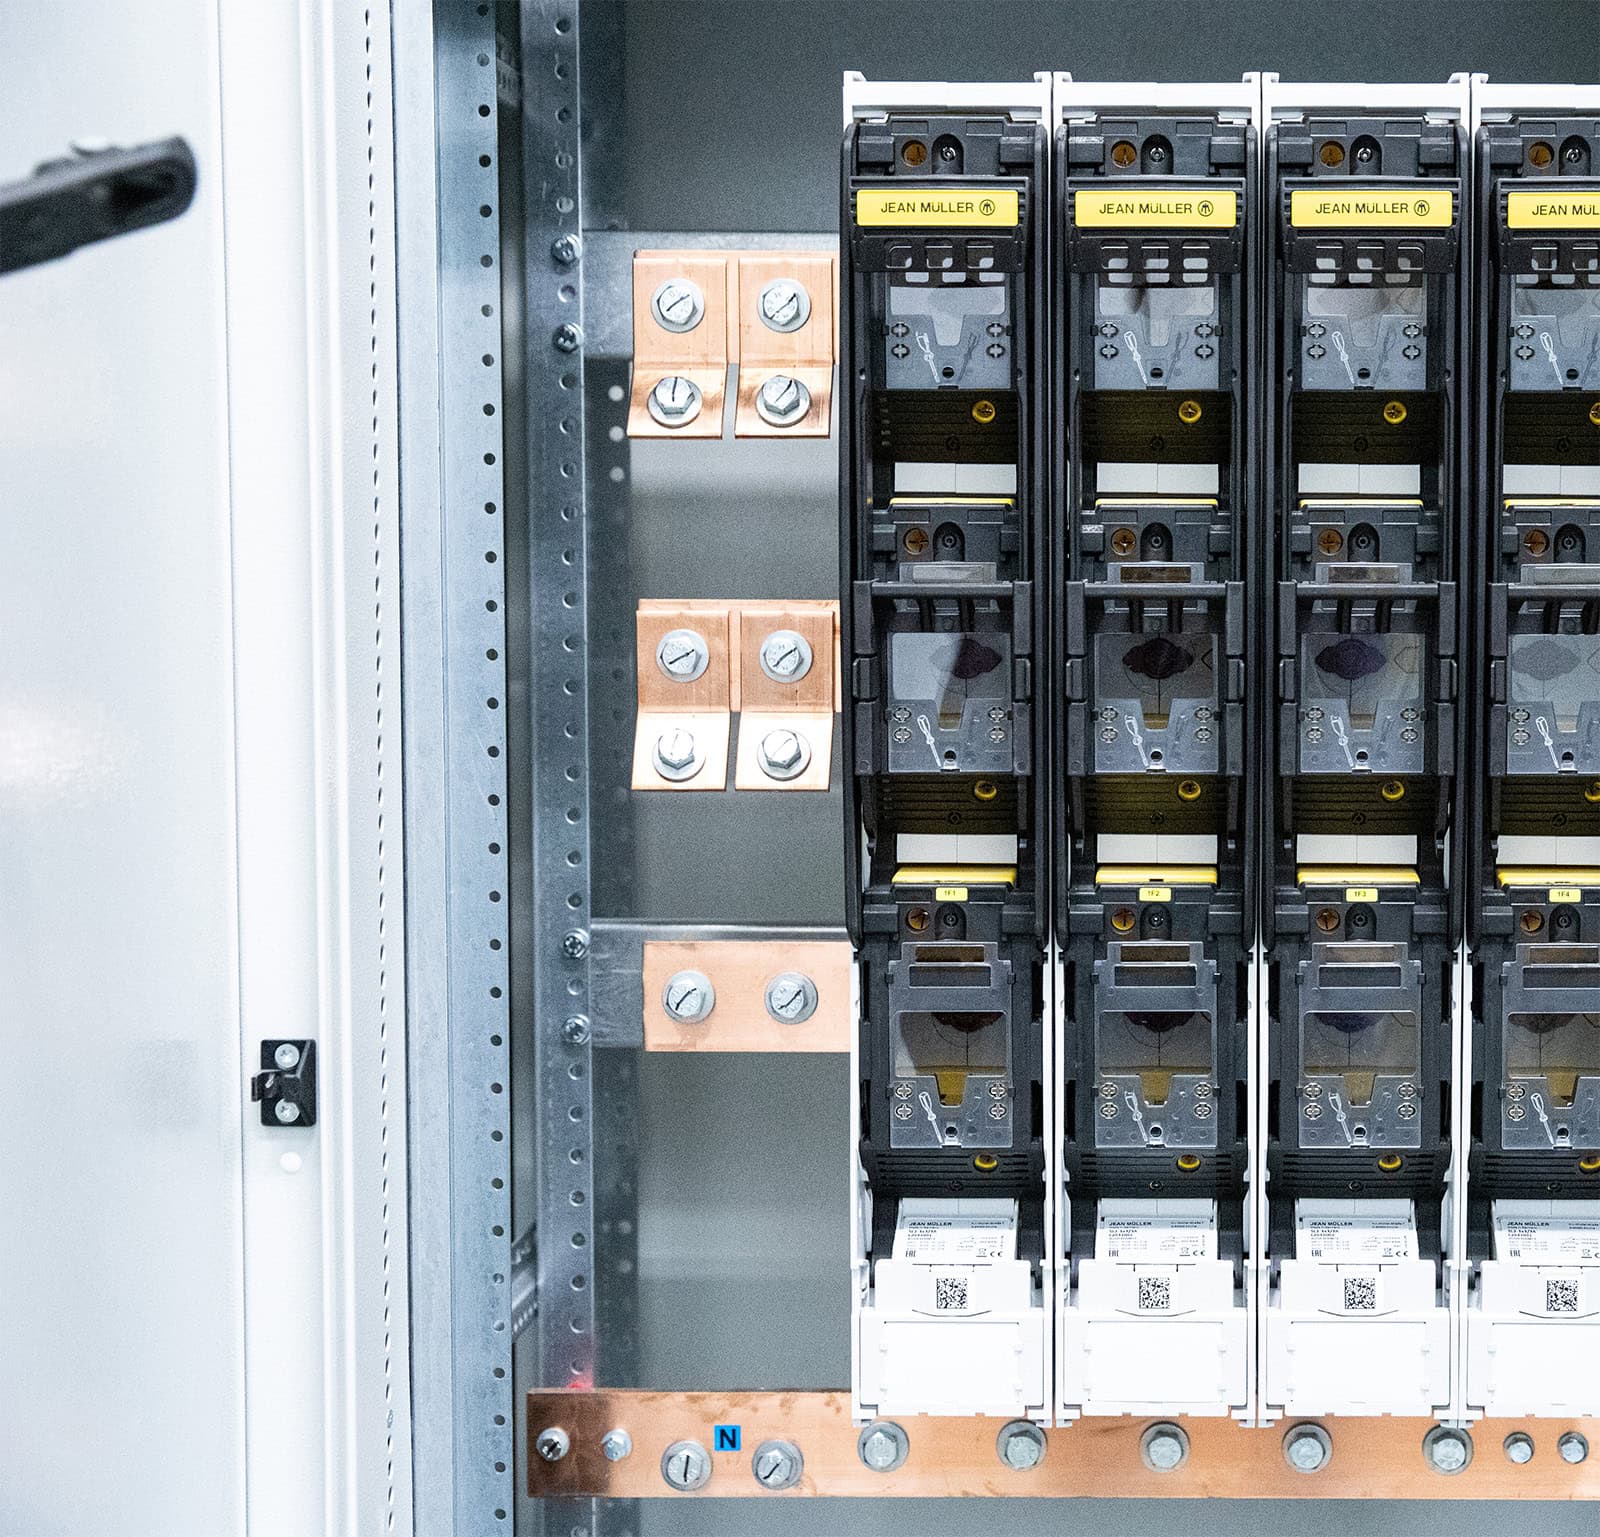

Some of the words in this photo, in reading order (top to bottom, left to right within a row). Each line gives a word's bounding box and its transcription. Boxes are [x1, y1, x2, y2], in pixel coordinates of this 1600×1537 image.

[880, 202, 916, 213] JEAN
[1099, 203, 1134, 214] JEAN
[1138, 203, 1192, 214] MÜLLER
[1315, 203, 1350, 214] JEAN
[1355, 203, 1408, 214] MÜLLER
[1531, 205, 1567, 216] JEAN
[719, 1428, 737, 1448] N
